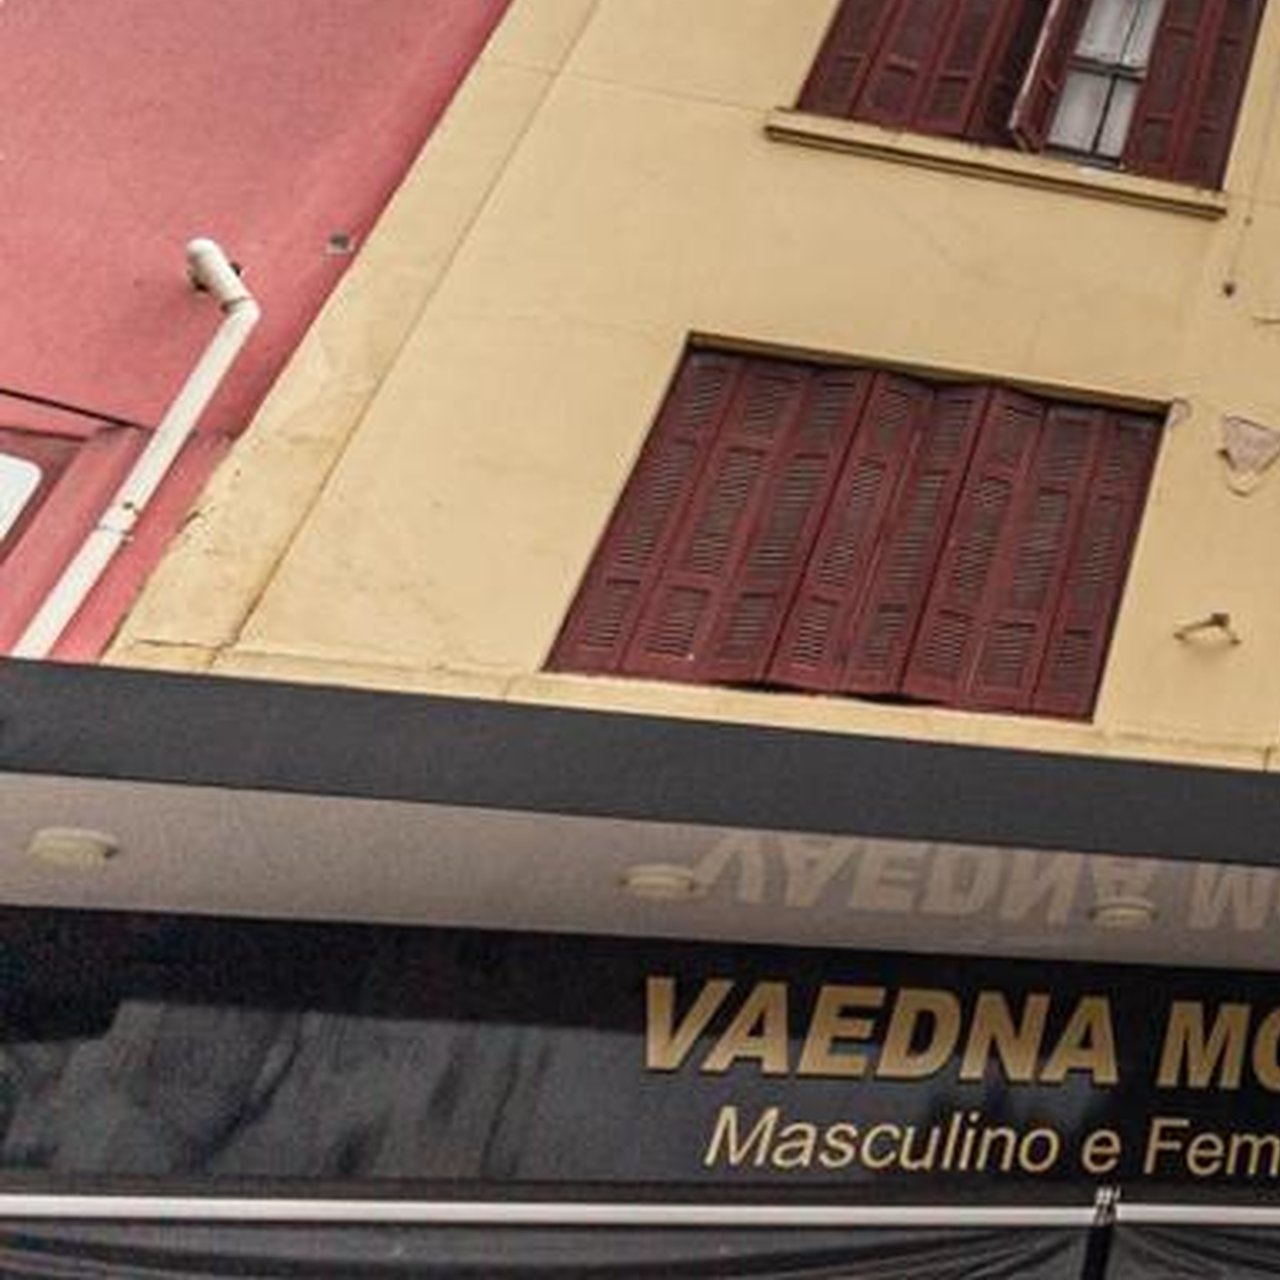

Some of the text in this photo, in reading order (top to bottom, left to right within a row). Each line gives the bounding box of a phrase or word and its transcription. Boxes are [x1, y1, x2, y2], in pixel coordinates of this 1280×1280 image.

[645, 976, 1119, 1087] VAEDNA
[704, 1105, 1059, 1172] Masculino
[1082, 1128, 1121, 1173] e
